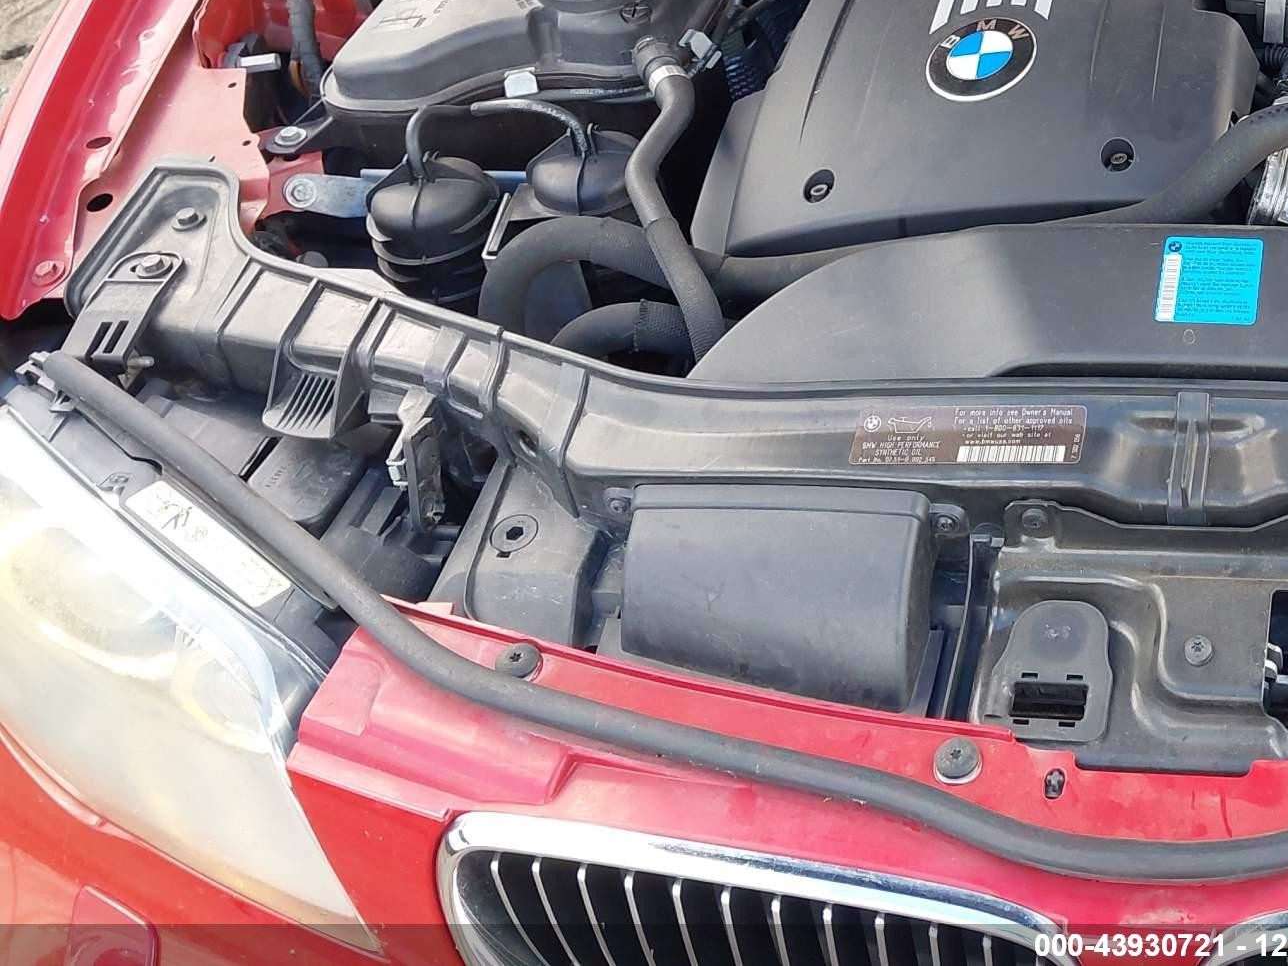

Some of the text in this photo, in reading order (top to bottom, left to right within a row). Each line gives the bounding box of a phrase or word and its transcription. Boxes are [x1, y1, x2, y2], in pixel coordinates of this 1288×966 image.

[940, 18, 1030, 50] BMW
[954, 408, 966, 416] For
[990, 408, 1004, 416] info
[1050, 407, 1073, 416] Manual
[954, 416, 966, 424] For
[977, 416, 989, 424] list
[992, 416, 1001, 424] of
[1003, 416, 1024, 424] other
[1025, 417, 1056, 425] approved
[1059, 416, 1073, 424] oils
[906, 433, 925, 443] only
[862, 440, 941, 449] BMW HIGH PERFORMANCE
[874, 448, 922, 456] SYNTHETIC OIL
